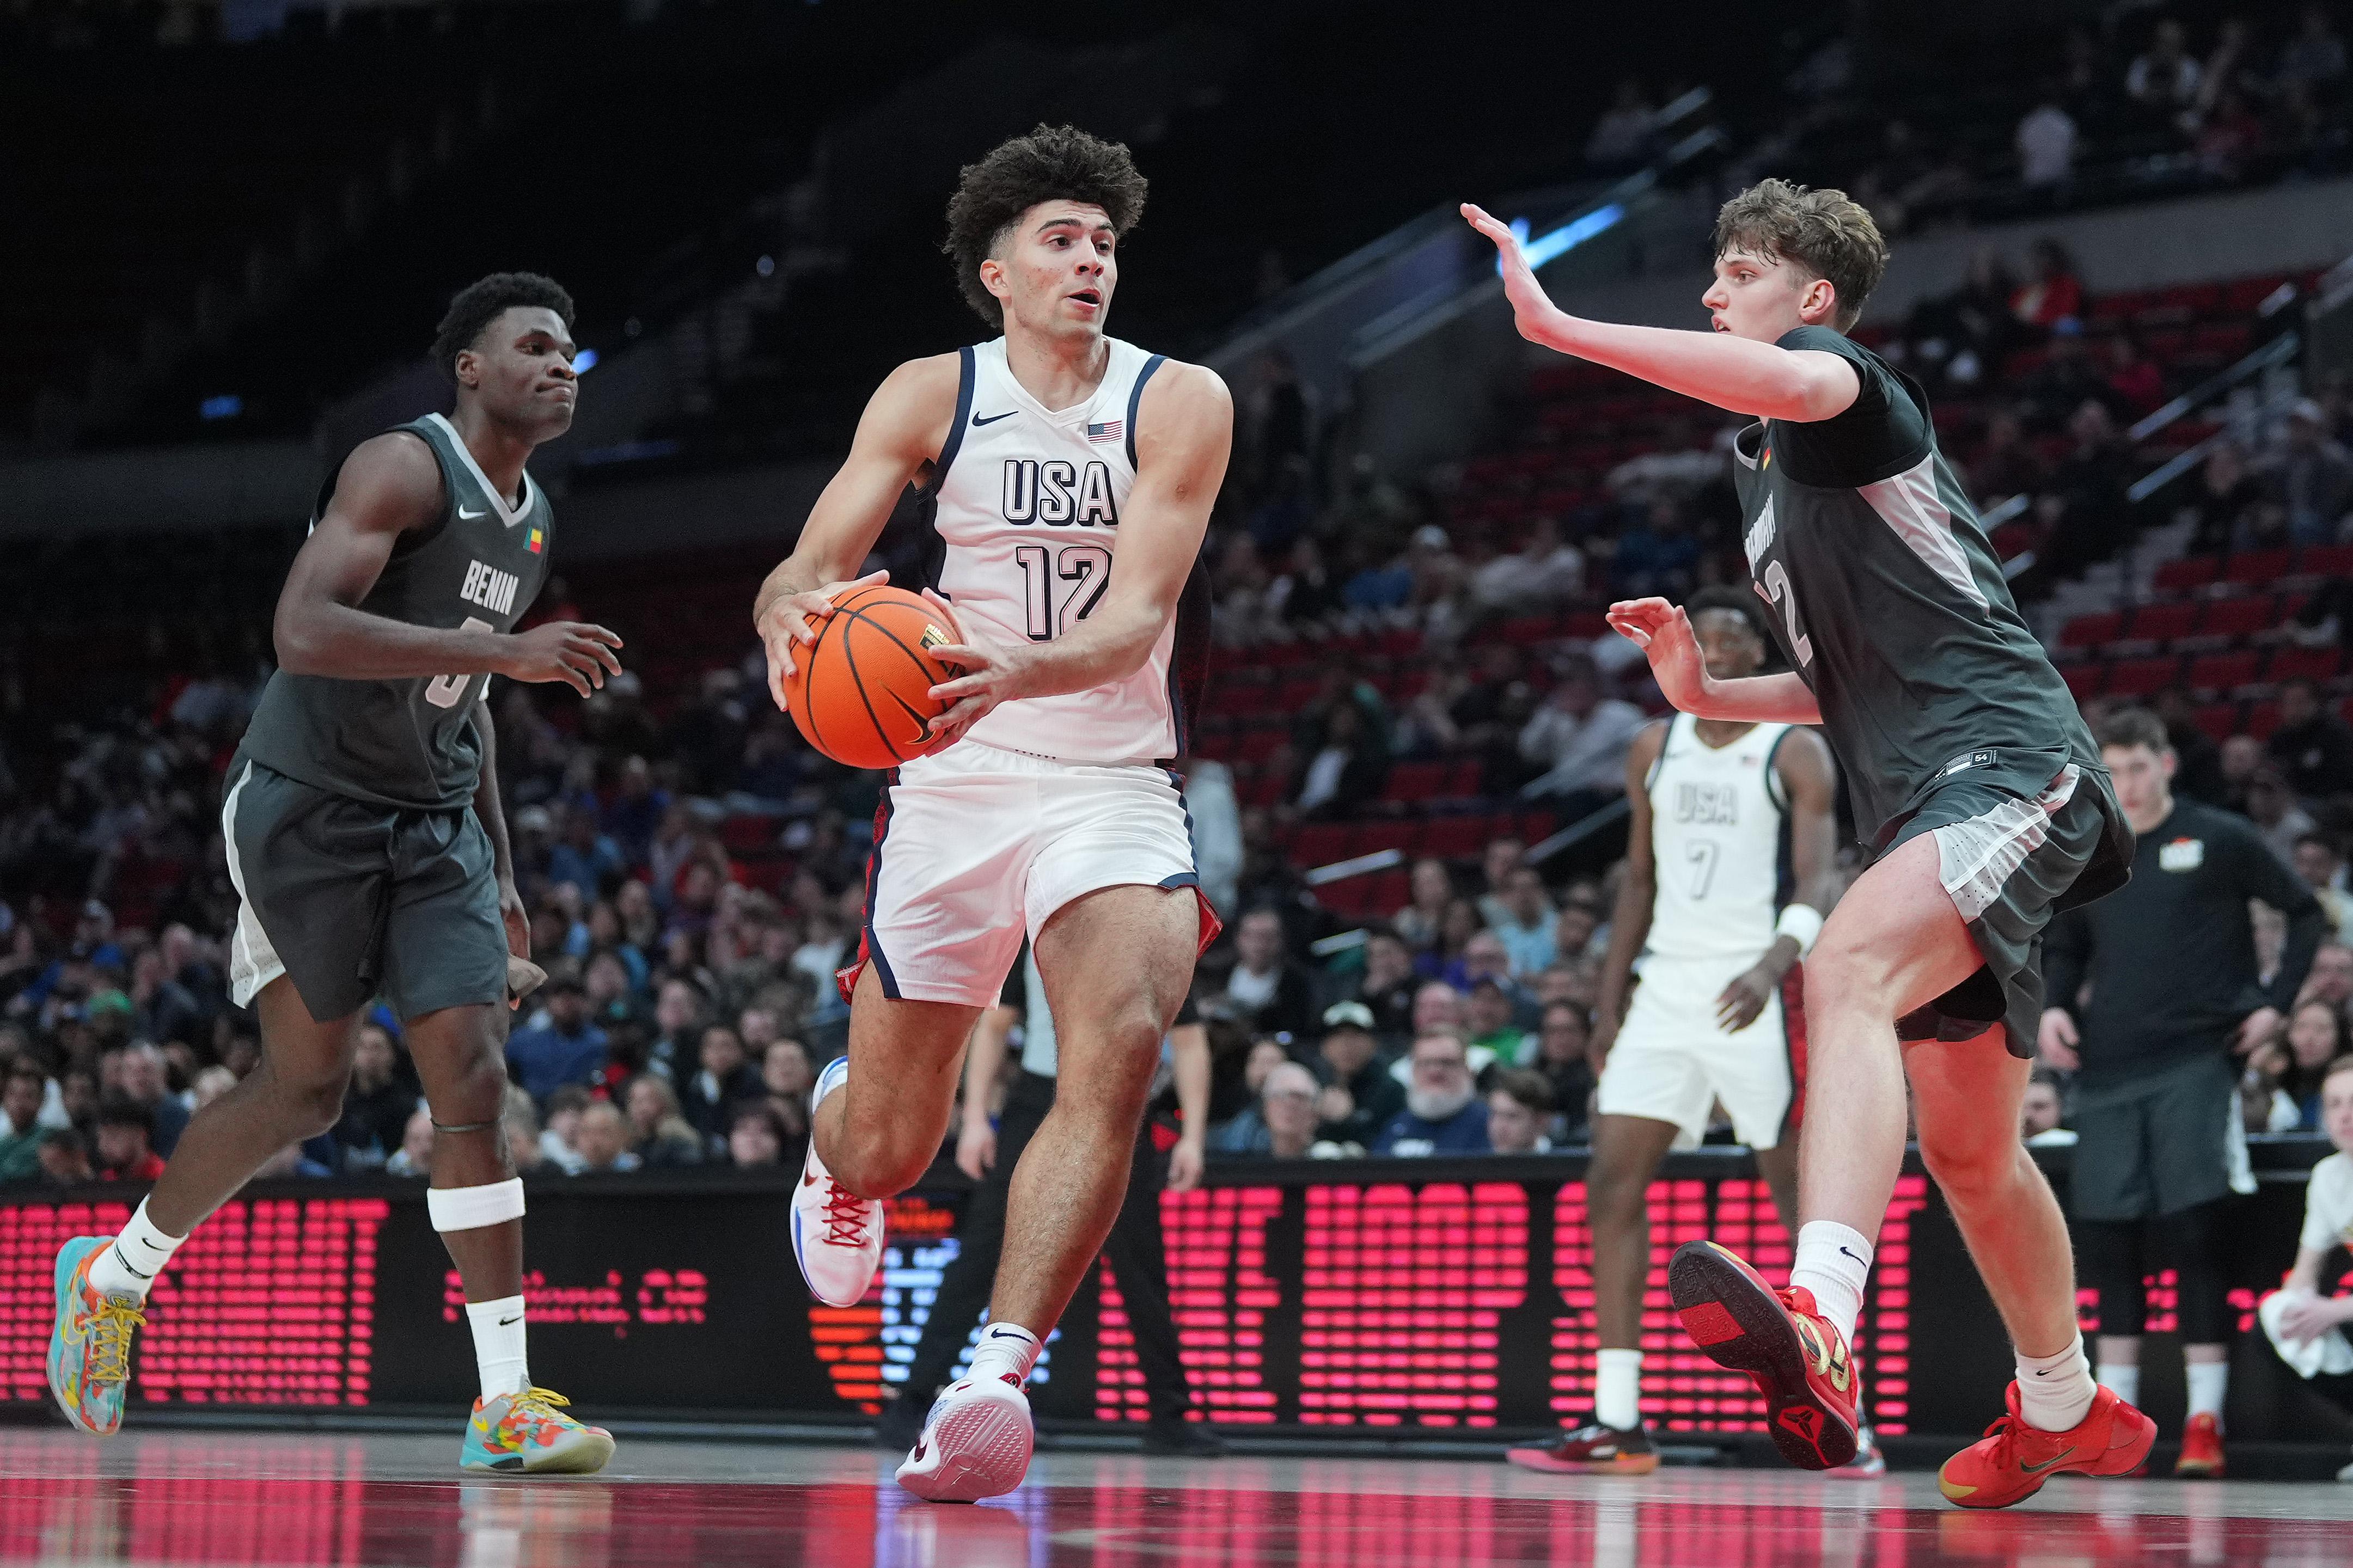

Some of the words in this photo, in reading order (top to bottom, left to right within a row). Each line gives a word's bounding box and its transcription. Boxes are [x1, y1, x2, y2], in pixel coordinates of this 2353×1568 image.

[1003, 460, 1119, 525] USA
[460, 559, 519, 616] BENIN
[1016, 546, 1113, 641] 12
[1674, 780, 1739, 826] USA
[1686, 837, 1721, 901] 7
[1299, 1181, 1529, 1428] HOOP
